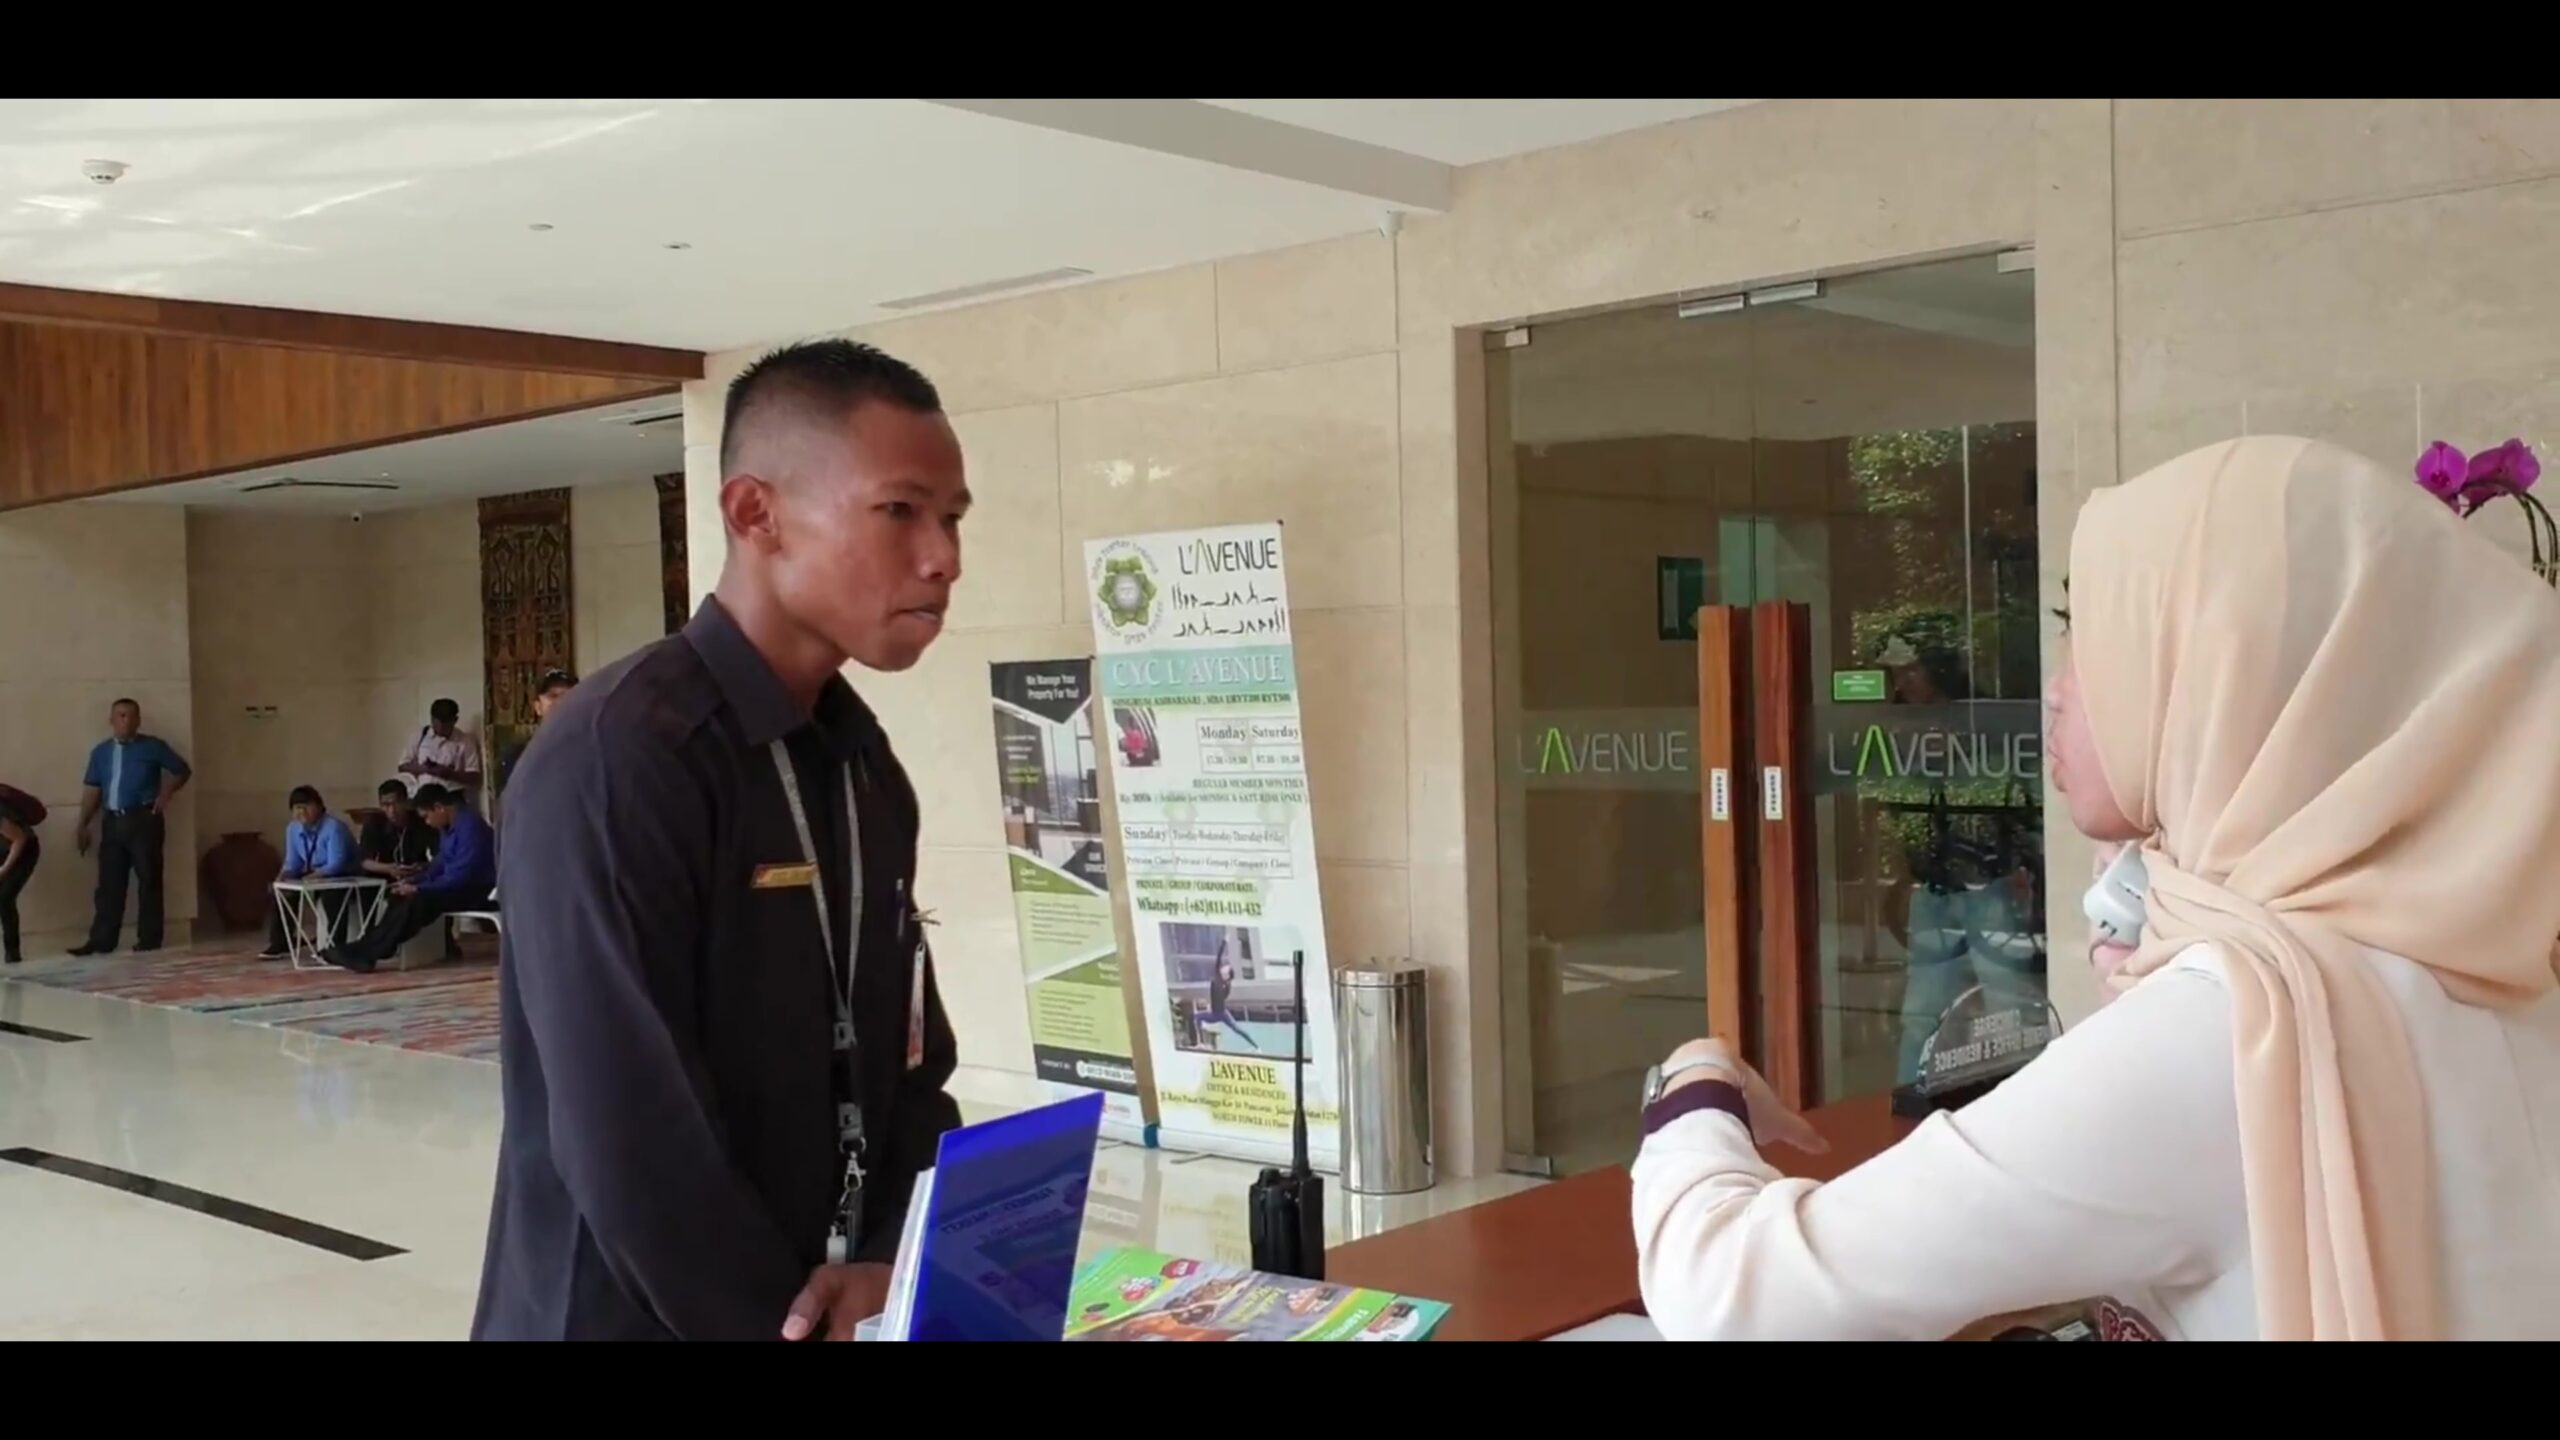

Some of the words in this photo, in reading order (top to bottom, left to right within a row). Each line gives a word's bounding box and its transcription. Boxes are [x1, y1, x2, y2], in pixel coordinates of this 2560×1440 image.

[1178, 538, 1278, 575] L'AVENUE
[1112, 658, 1161, 688] CYC
[1200, 725, 1246, 740] Monday
[1251, 724, 1300, 740] Saturday
[1828, 724, 2039, 778] L'AVENUE
[1124, 826, 1167, 843] Sunday
[1137, 897, 1179, 915] Whatsapp
[1210, 1060, 1276, 1084] L'AVENUE
